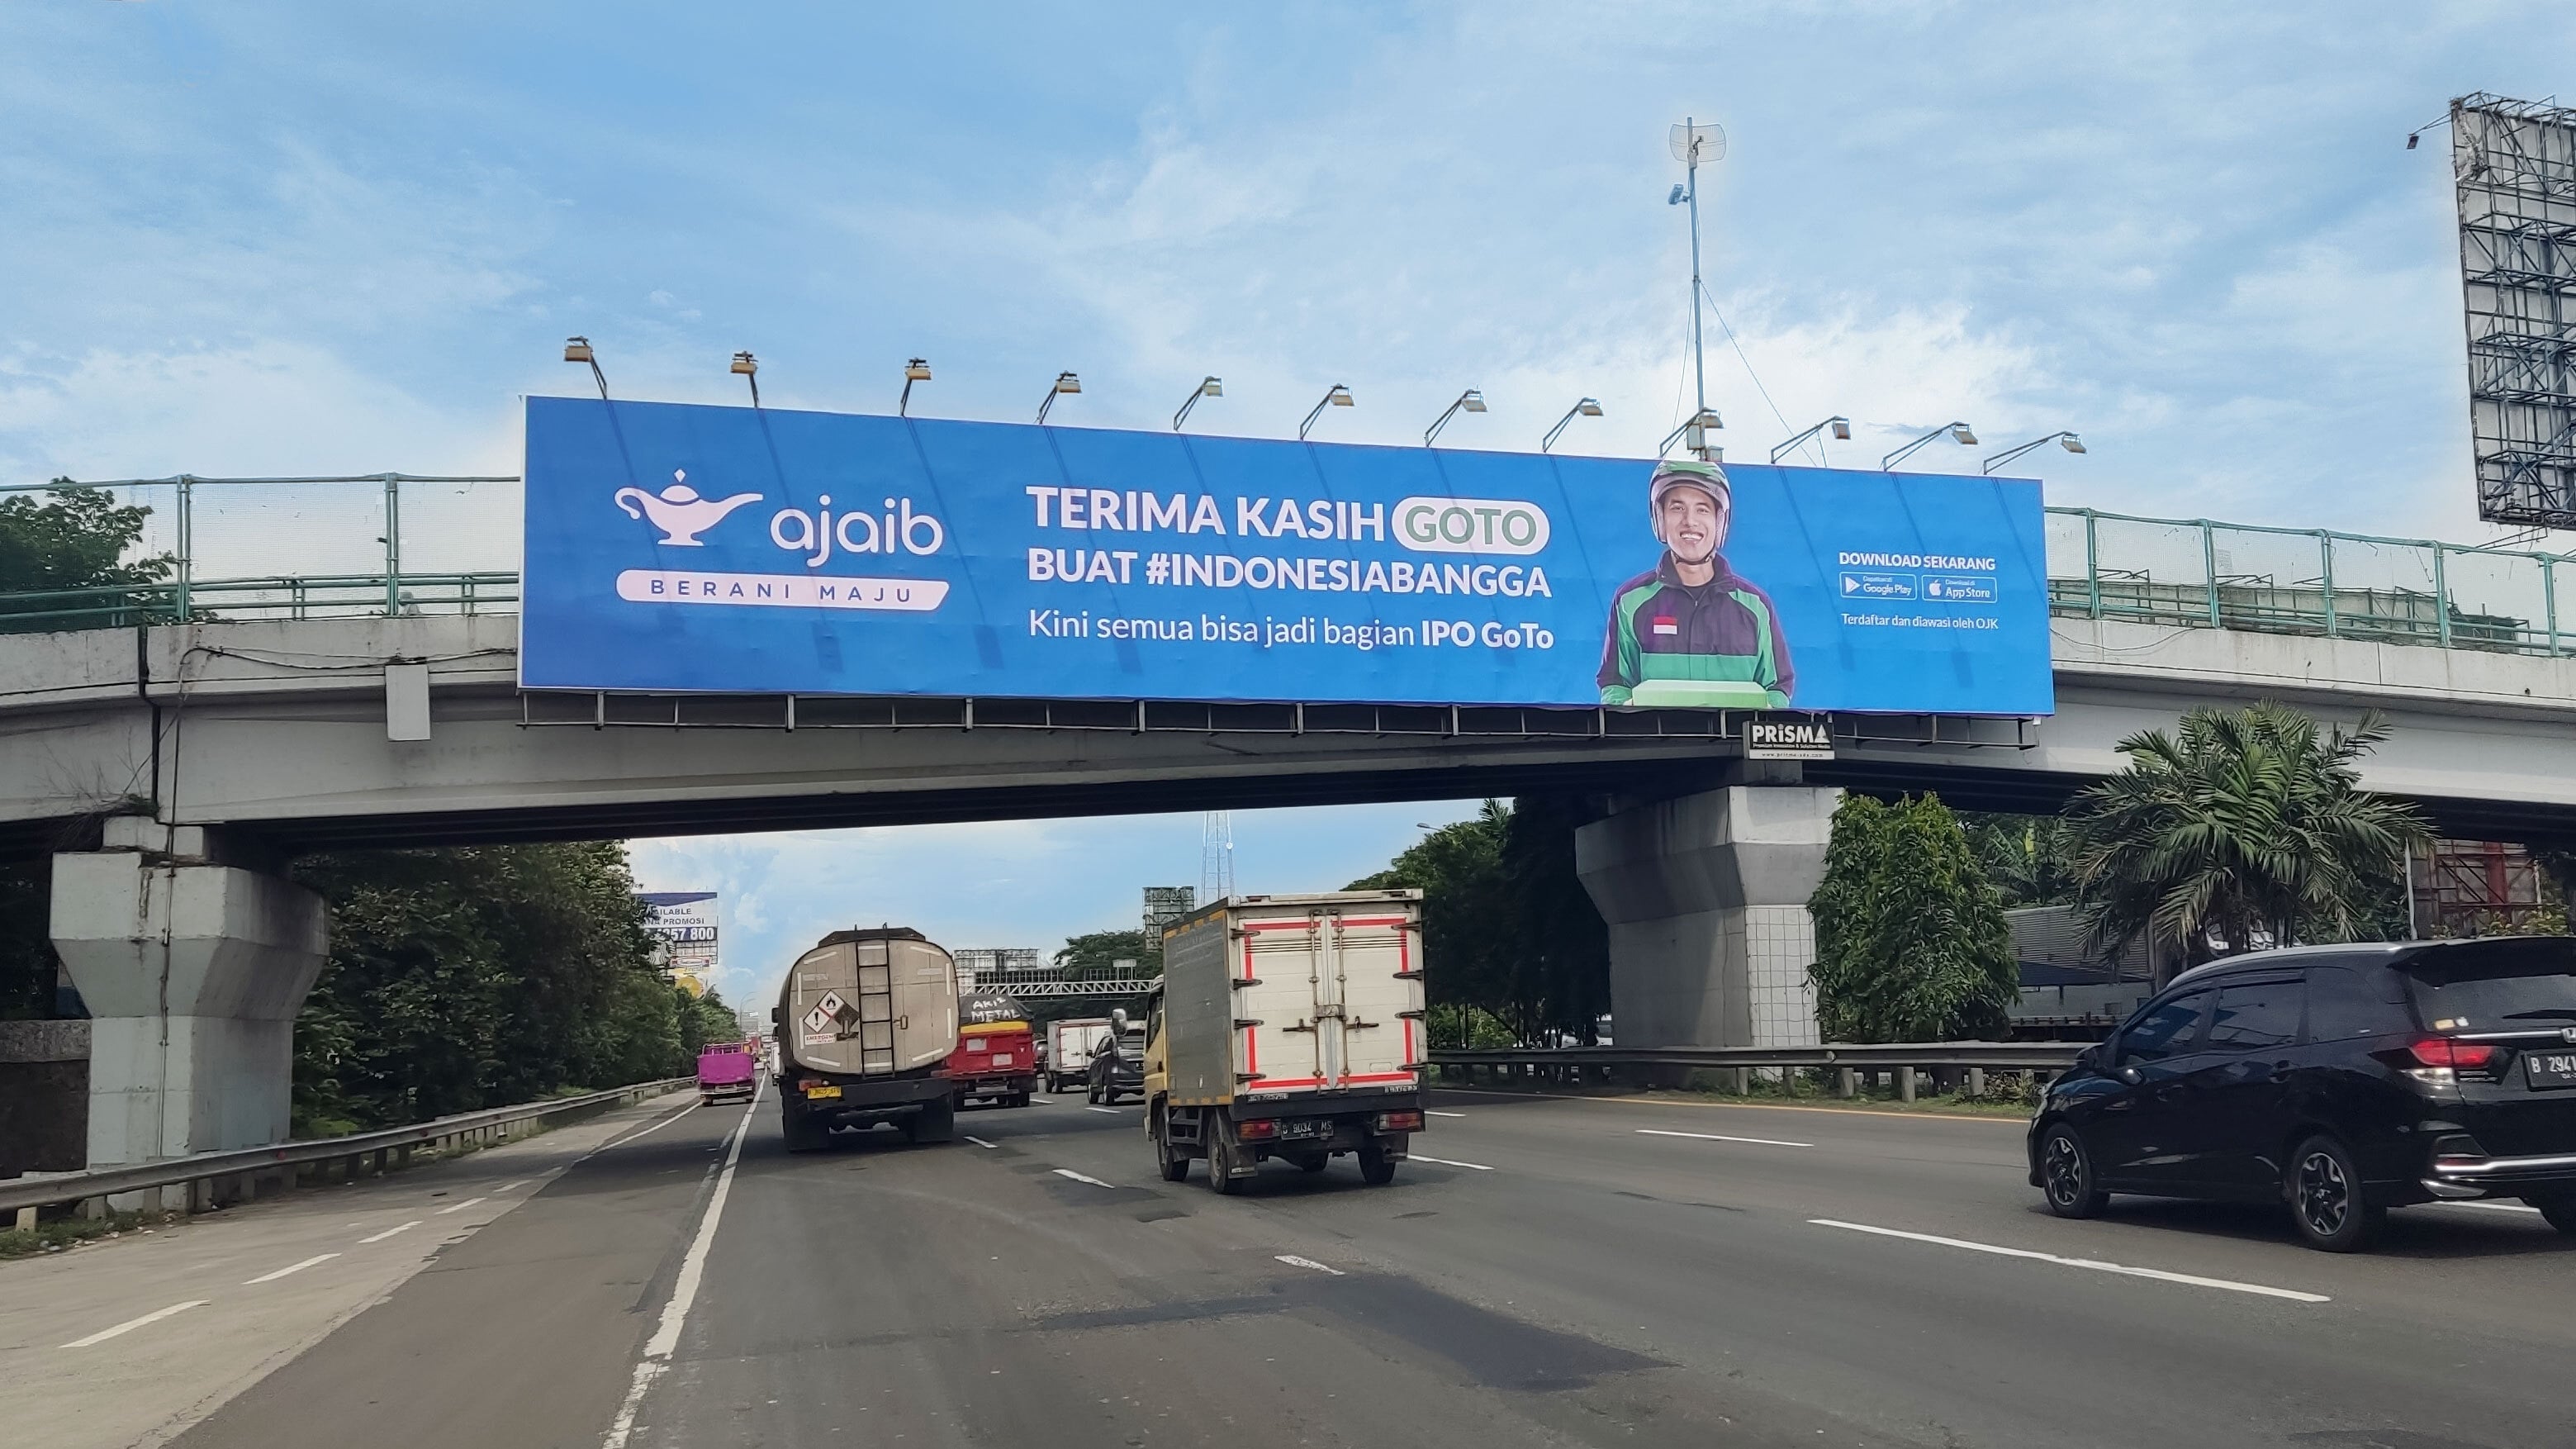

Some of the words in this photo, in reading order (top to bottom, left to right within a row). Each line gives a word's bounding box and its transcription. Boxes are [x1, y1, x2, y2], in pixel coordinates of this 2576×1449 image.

[1026, 486, 1227, 535] TERIMA
[1236, 496, 1384, 542] KASIH
[1405, 506, 1537, 547] GOTO
[770, 494, 943, 568] ajaib
[1838, 552, 1921, 568] DOWNLOAD
[1924, 556, 1996, 571] SEKARANG
[1028, 548, 1138, 584] BUAT
[1146, 553, 1553, 598] #INDONESIABANGGA
[651, 579, 790, 600] BERANI
[819, 584, 911, 603] MAJU
[1862, 583, 1894, 596] Google
[1895, 585, 1912, 596] Play
[1945, 587, 1965, 599] App
[1966, 587, 1991, 598] Store
[1841, 613, 1890, 626] Terdaftar
[1891, 615, 1911, 627] dan
[1912, 615, 1951, 628] diawasi
[1952, 617, 1975, 629] oleh
[1976, 618, 1999, 629] OJK
[1030, 609, 1089, 638] Kini
[1097, 618, 1193, 640] semua
[1202, 614, 1258, 643] bisa
[1264, 616, 1316, 648] jadi
[1324, 617, 1414, 650] bagian
[1422, 620, 1476, 647] IPO
[1481, 621, 1554, 649] GoTo
[663, 917, 704, 925] PROMOSI
[690, 928, 714, 941] 800
[971, 1009, 1021, 1022] METAL
[2531, 1057, 2541, 1073] B
